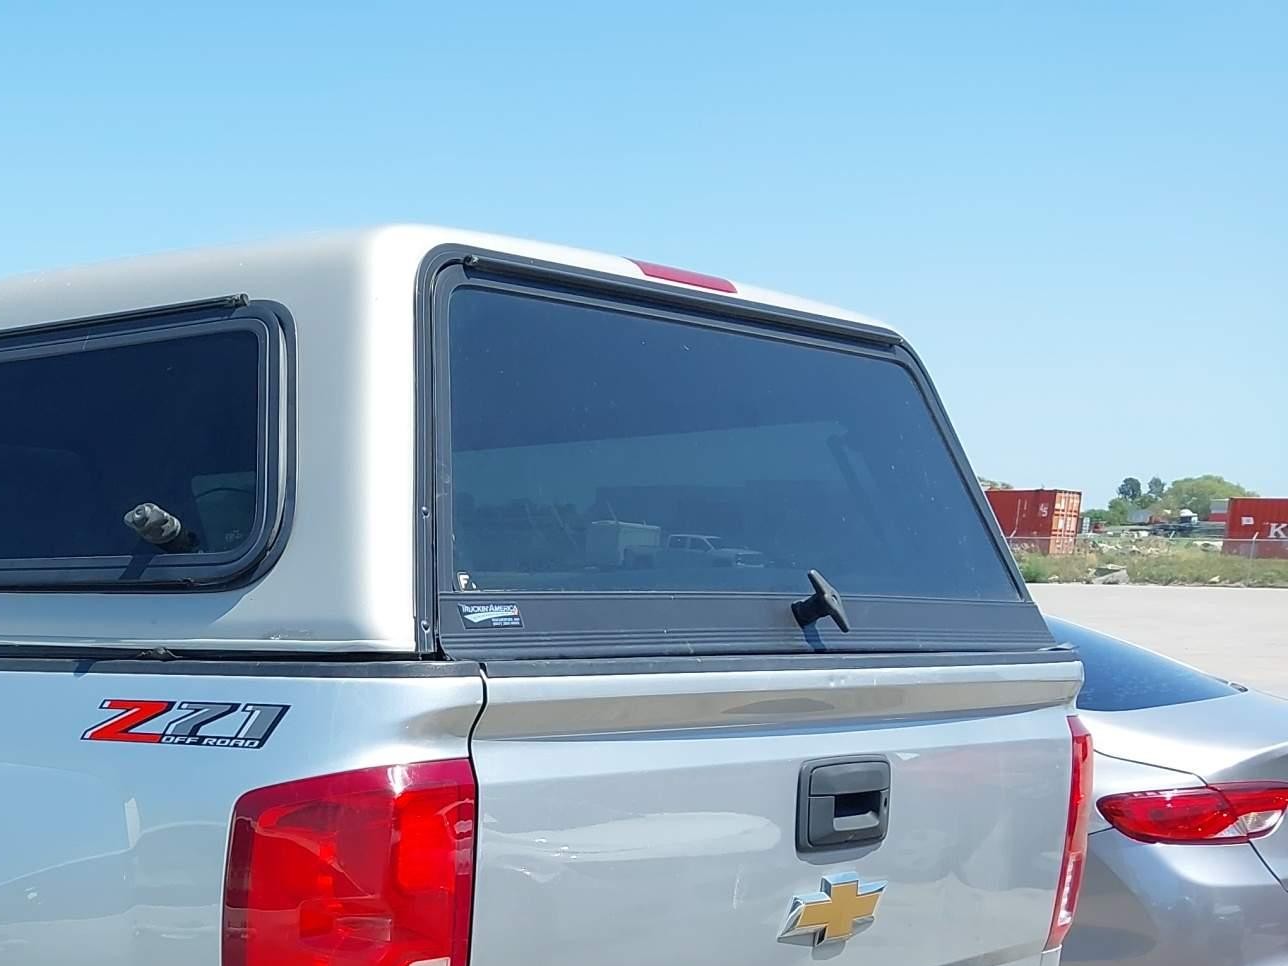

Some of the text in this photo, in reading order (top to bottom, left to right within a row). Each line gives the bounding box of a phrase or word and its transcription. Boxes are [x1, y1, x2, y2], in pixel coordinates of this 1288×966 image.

[80, 698, 293, 748] Z71
[159, 735, 261, 748] OFF ROAD
